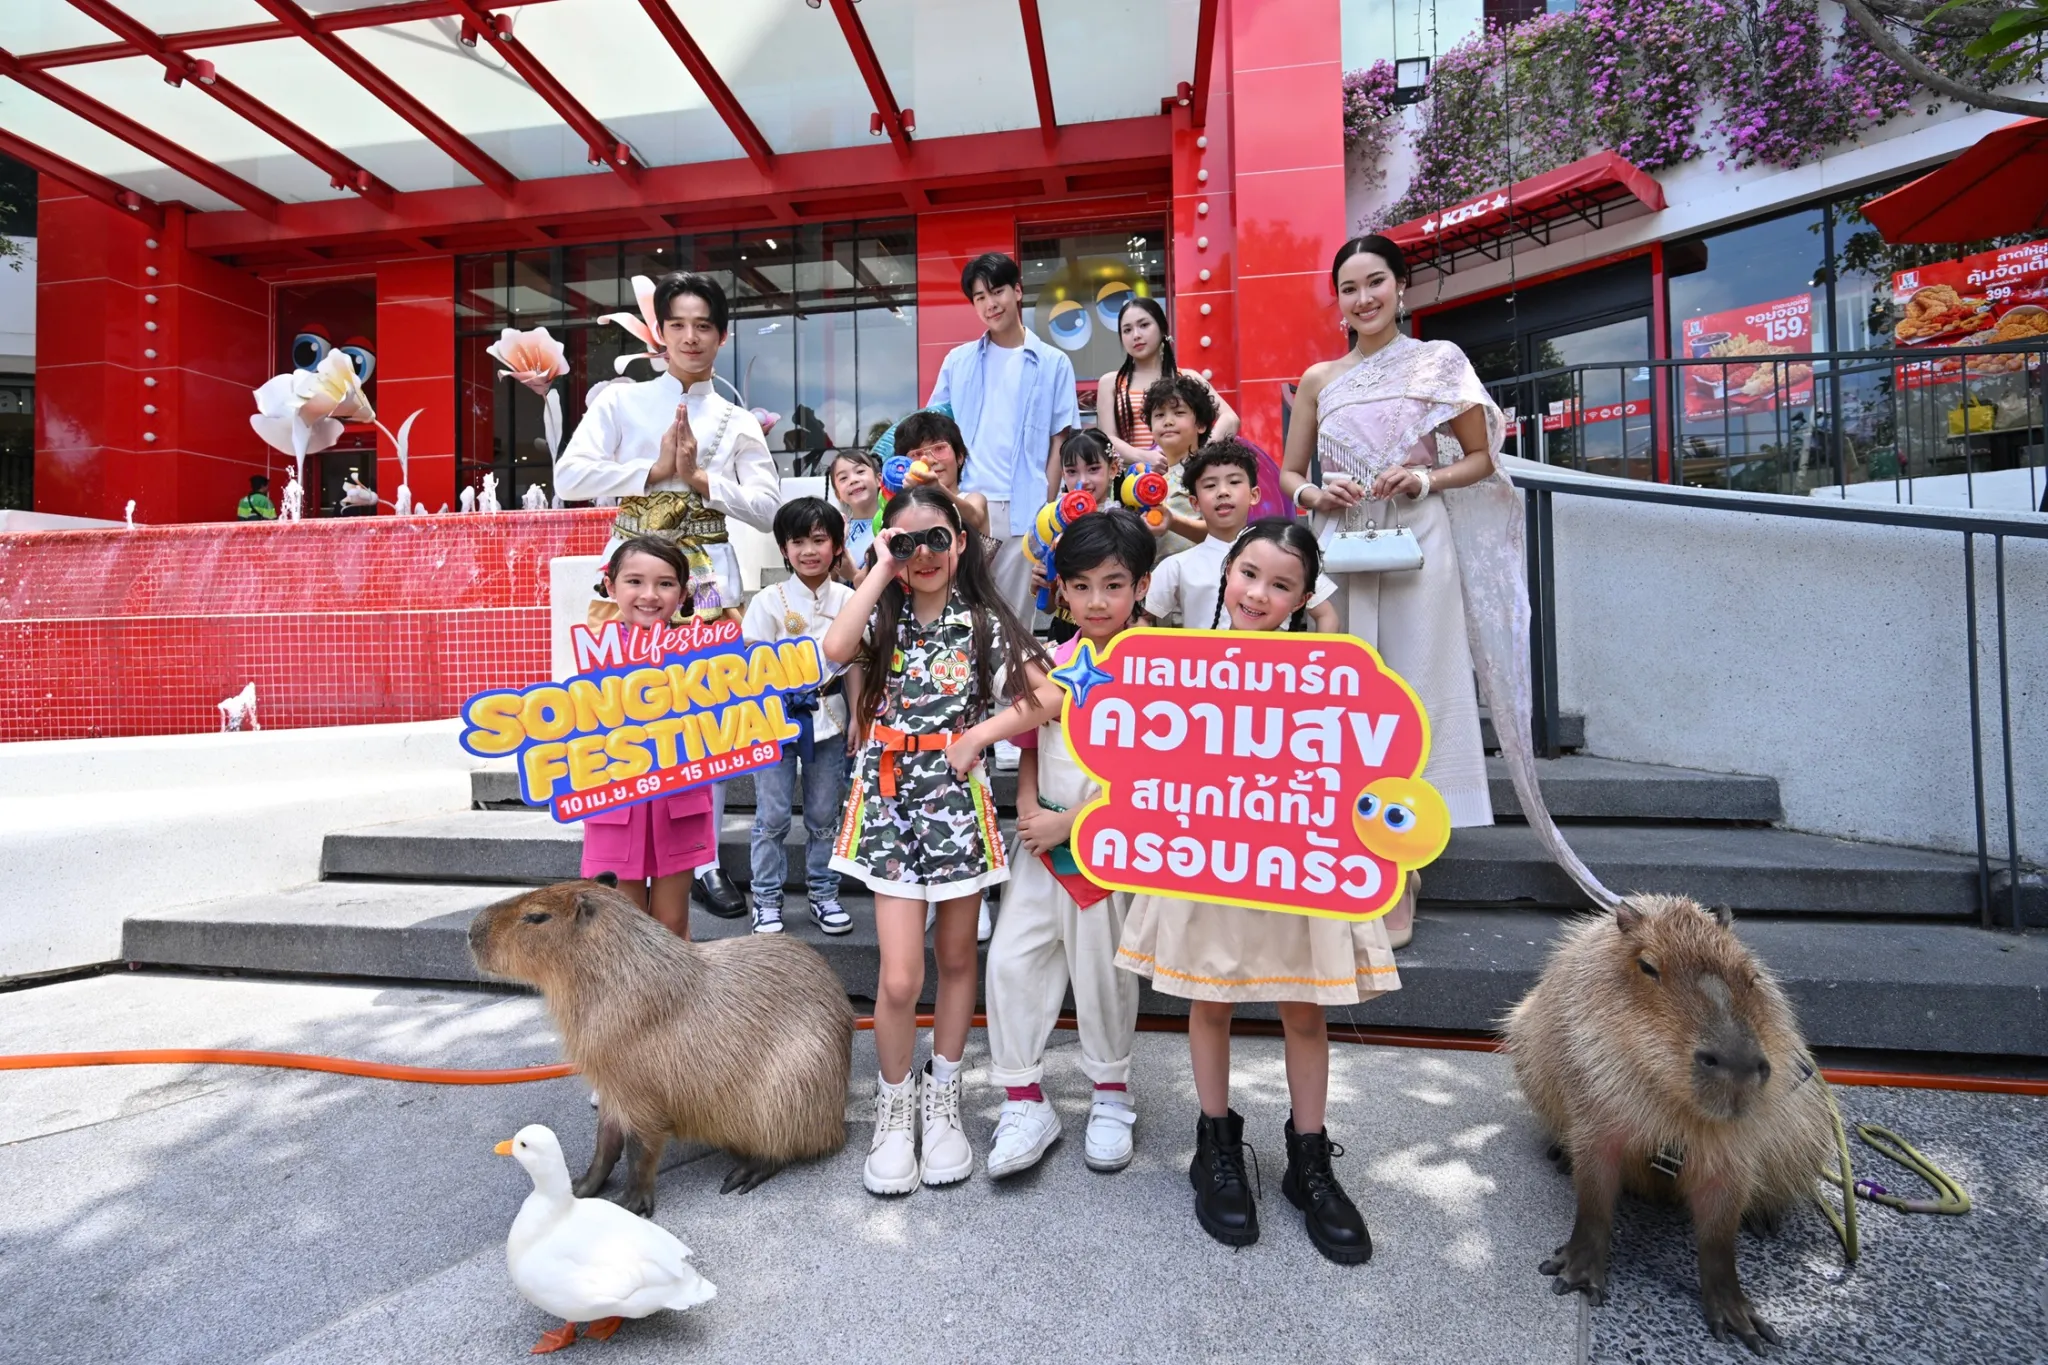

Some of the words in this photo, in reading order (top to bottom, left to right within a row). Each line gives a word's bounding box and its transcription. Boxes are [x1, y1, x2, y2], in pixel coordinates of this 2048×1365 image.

[1440, 199, 1488, 229] KFC
[1745, 304, 1809, 325] จอยจอย
[574, 623, 623, 670] M
[628, 619, 739, 663] Lifestore
[934, 664, 946, 675] VA
[467, 639, 820, 753] SONGKRAN
[955, 667, 966, 677] VA
[1122, 648, 1359, 696] แลนด์มาร์ก
[524, 695, 800, 801] FESTIVAL
[1090, 698, 1400, 791] ความสุข
[560, 798, 582, 814] 10
[637, 776, 660, 794] 69
[681, 764, 702, 782] 15
[753, 744, 774, 762] 69
[1131, 770, 1336, 828] สนุกได้ทั้ง
[1092, 828, 1383, 899] ครอบครัว
